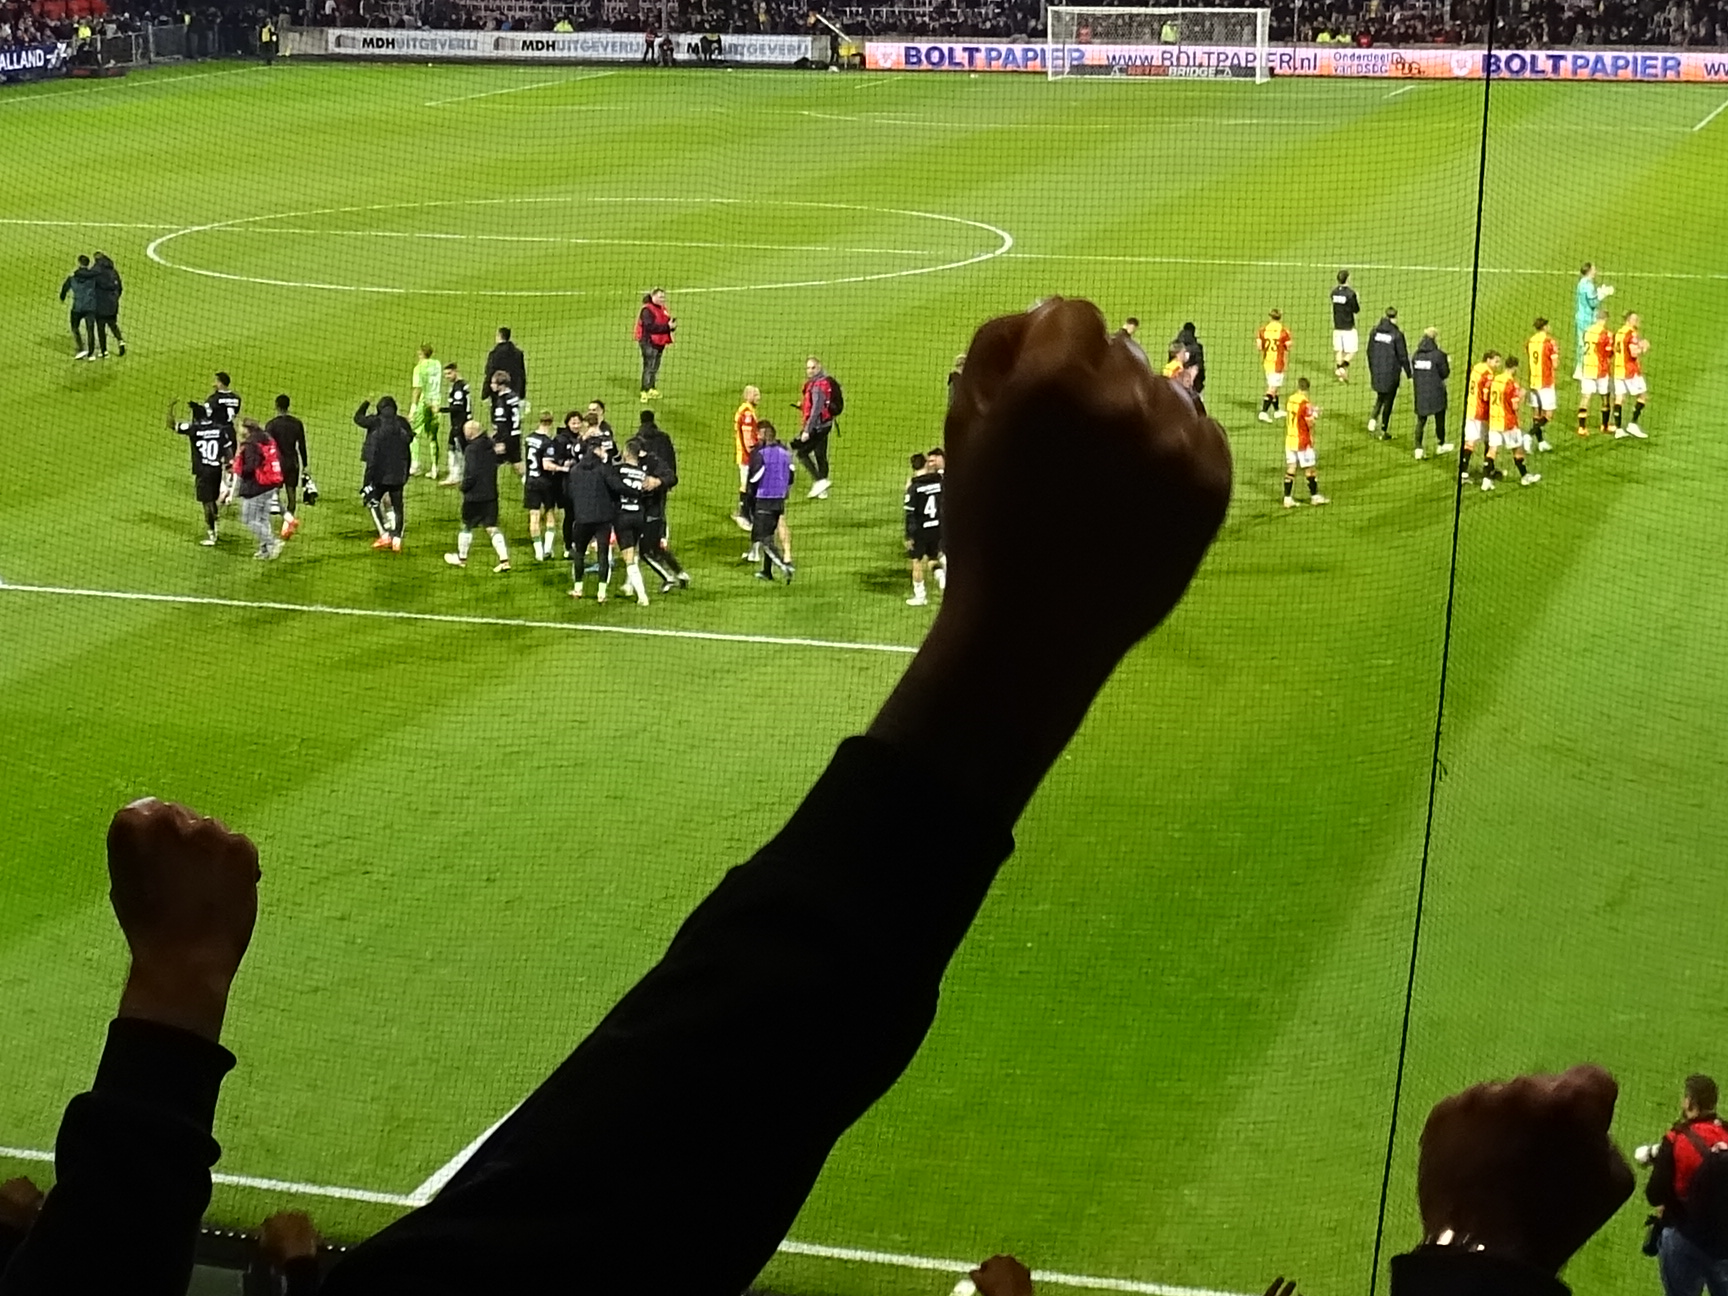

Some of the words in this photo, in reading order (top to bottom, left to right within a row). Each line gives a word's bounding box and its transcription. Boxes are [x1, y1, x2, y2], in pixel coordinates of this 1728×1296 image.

[1105, 47, 1318, 72] www.BOLTPAPER.nl
[195, 439, 220, 461] 30
[923, 494, 937, 519] 4
